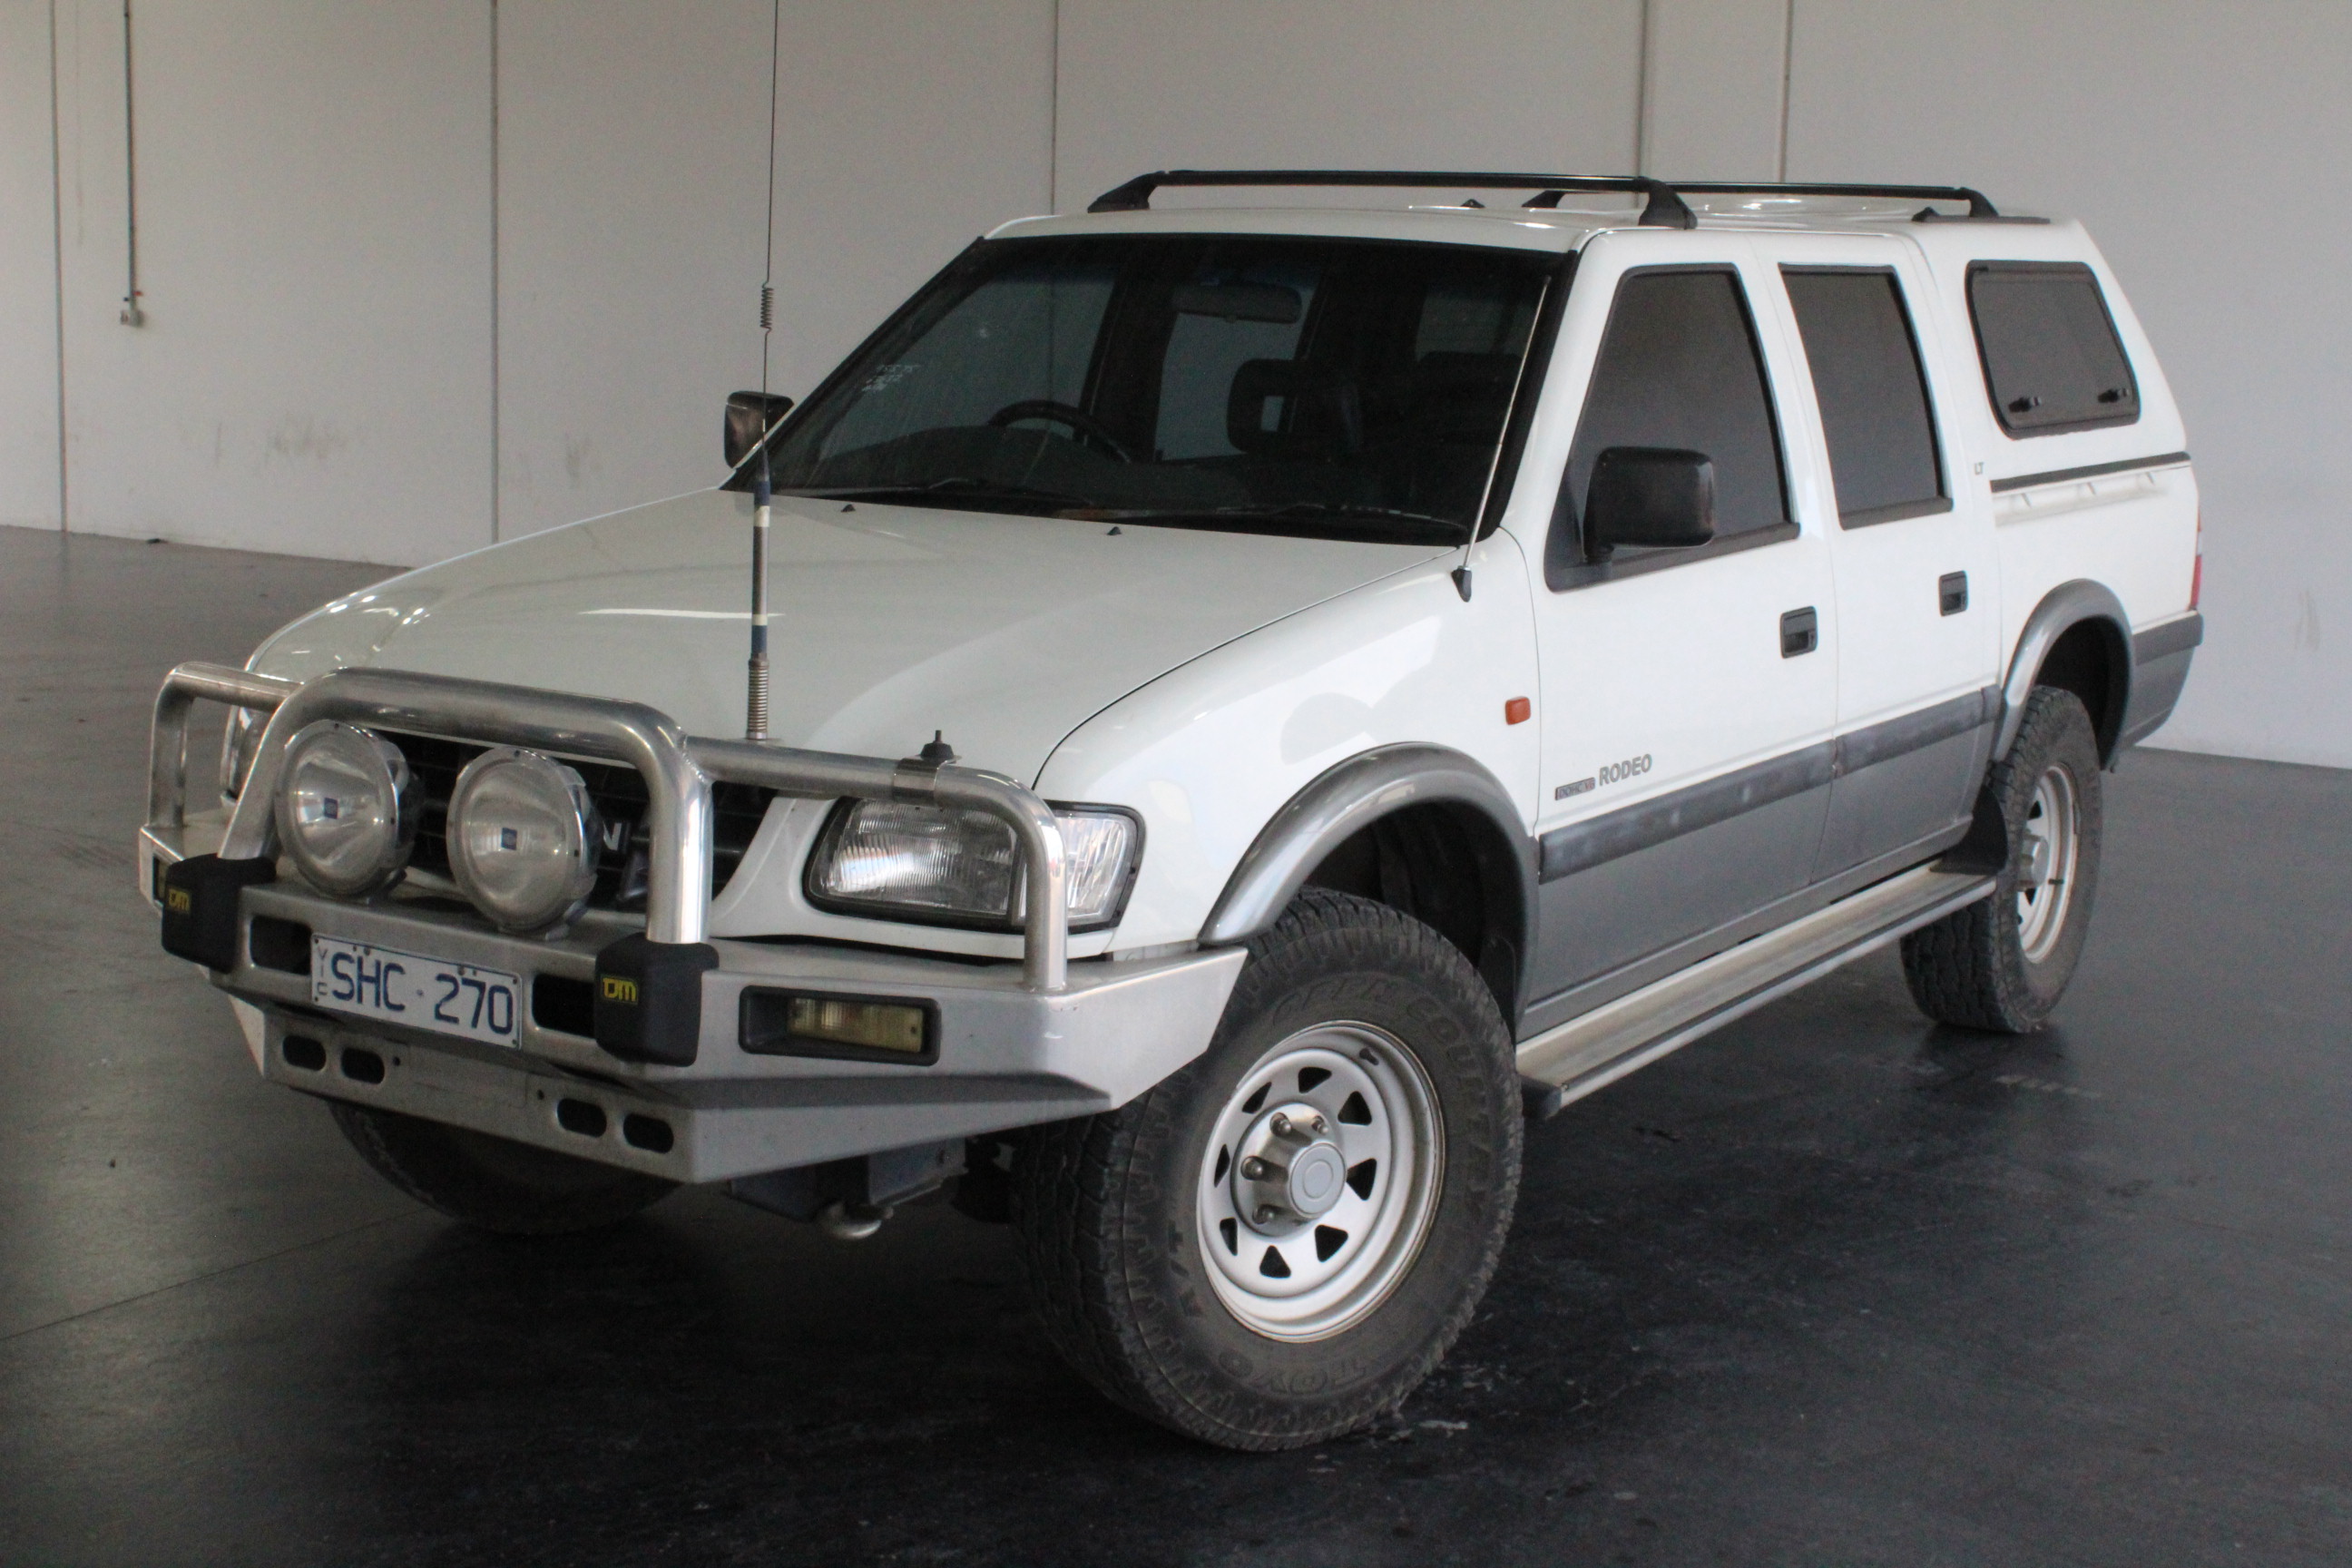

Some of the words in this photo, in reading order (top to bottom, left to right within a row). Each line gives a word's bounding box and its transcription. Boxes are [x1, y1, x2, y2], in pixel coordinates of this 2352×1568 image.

[1599, 753, 1652, 786] RODEO
[331, 951, 407, 1012] SHC
[434, 973, 514, 1035] 270
